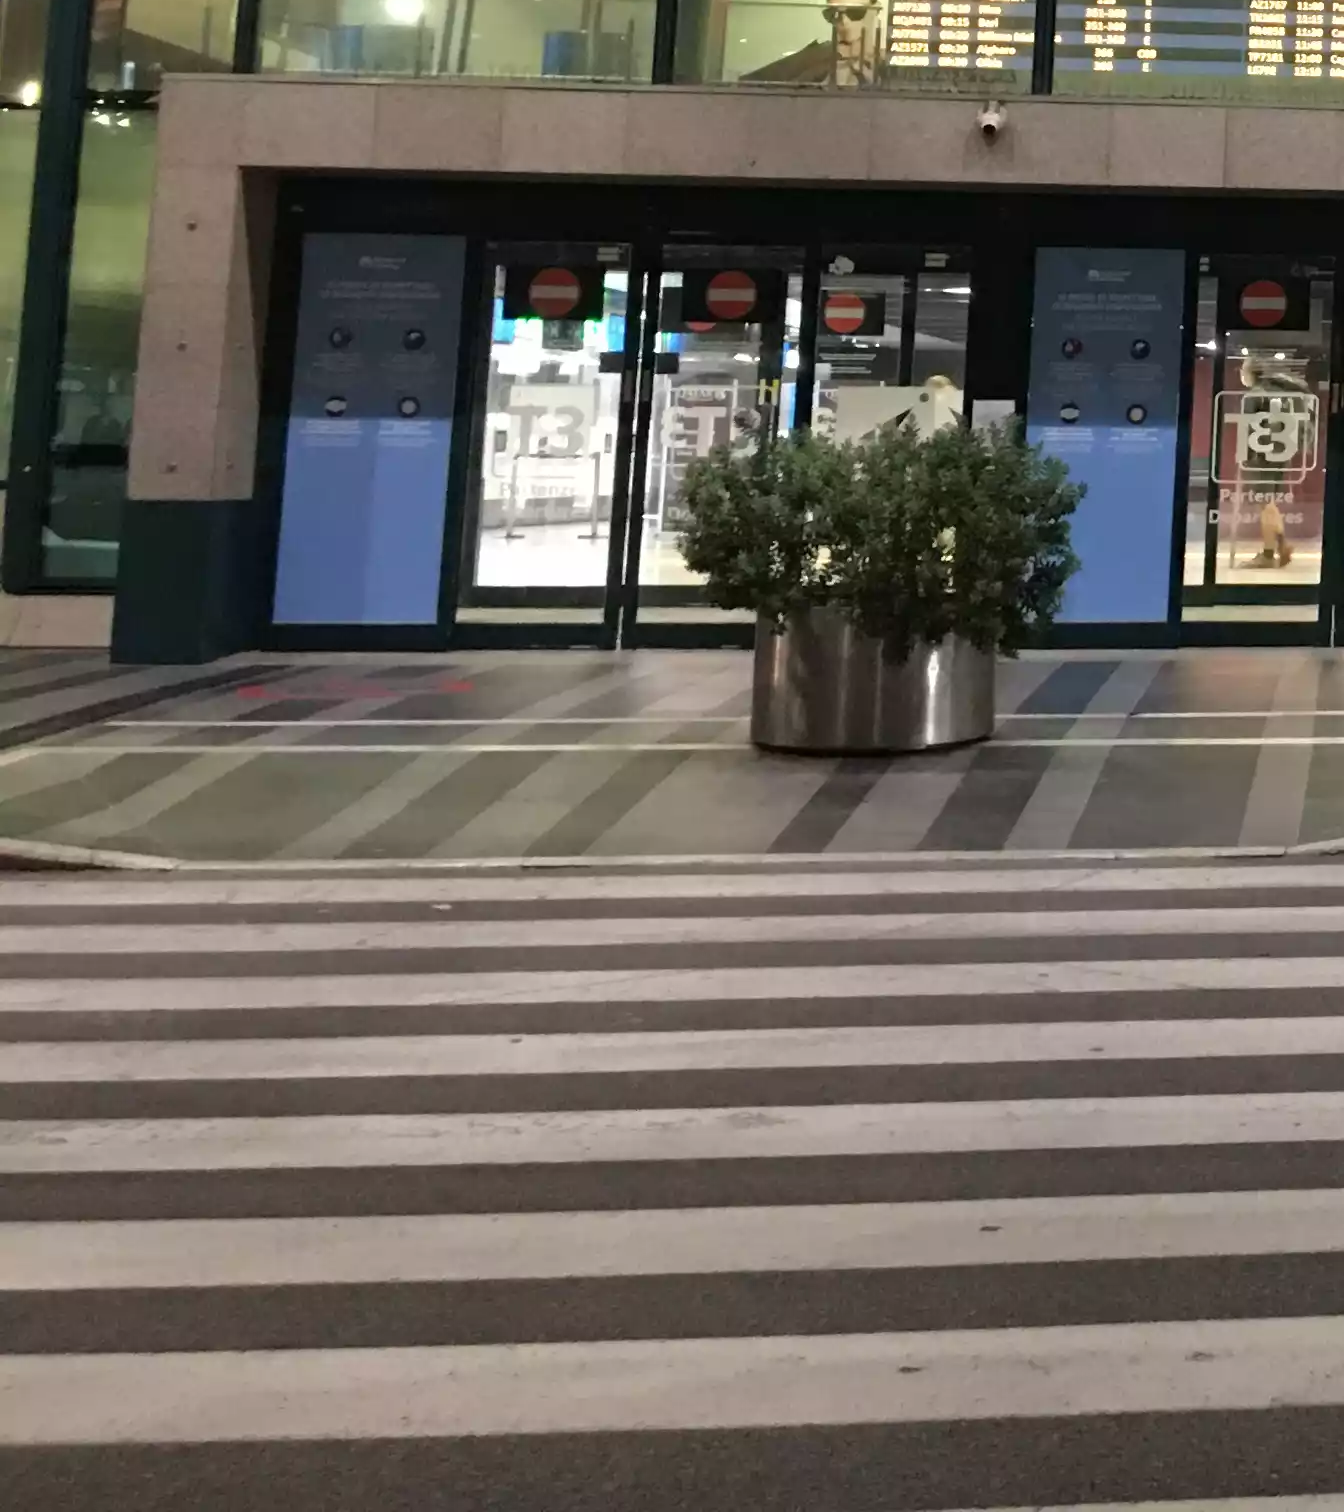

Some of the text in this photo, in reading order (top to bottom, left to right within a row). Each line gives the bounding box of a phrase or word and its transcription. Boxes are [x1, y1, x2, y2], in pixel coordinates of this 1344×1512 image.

[976, 45, 1017, 56] Alghero
[509, 406, 585, 457] T3
[1219, 488, 1294, 504] Partenze
